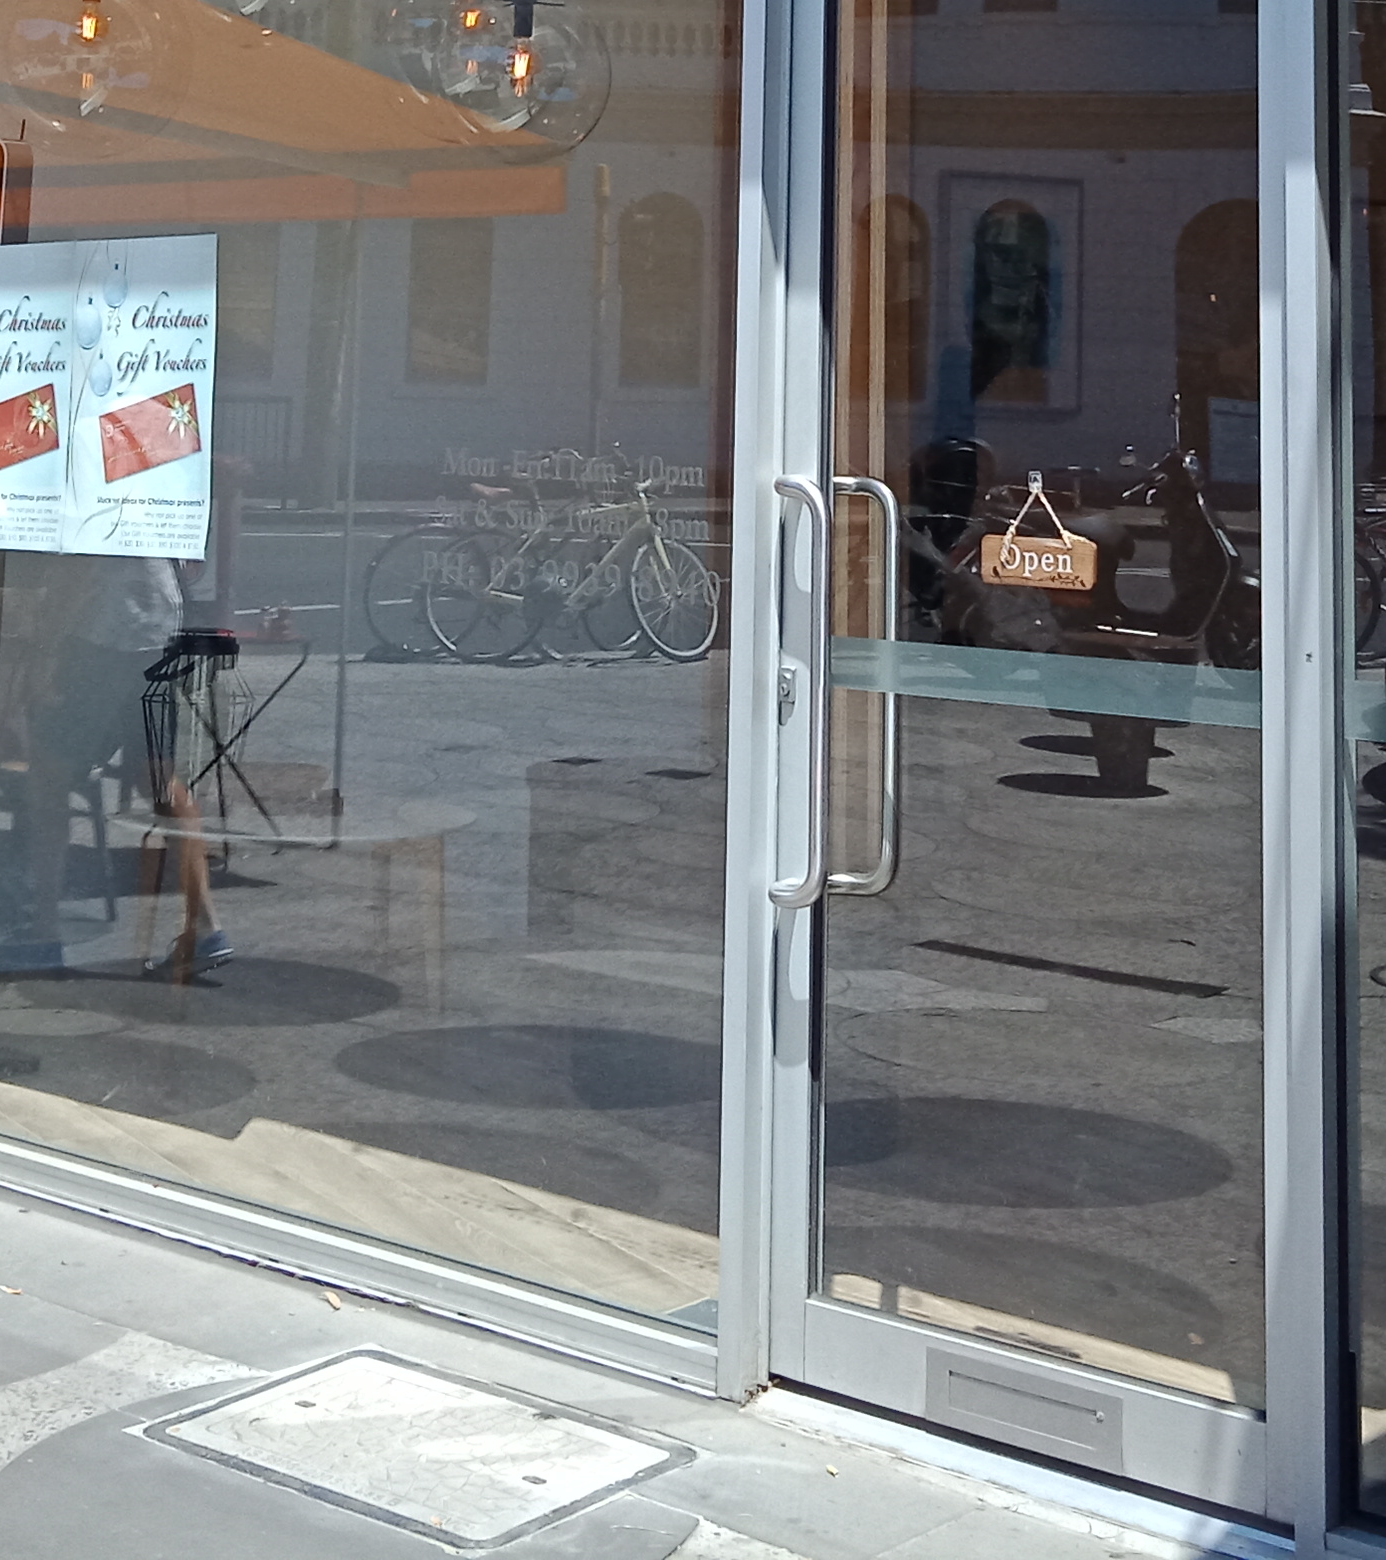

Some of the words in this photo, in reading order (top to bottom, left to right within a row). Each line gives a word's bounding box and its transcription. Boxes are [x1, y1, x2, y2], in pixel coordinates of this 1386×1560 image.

[131, 291, 210, 330] Christmas
[16, 341, 66, 374] Vouchers
[116, 338, 155, 396] Gift
[153, 338, 208, 373] Vouchers
[635, 454, 705, 495] 10pm
[1002, 543, 1073, 577] Open
